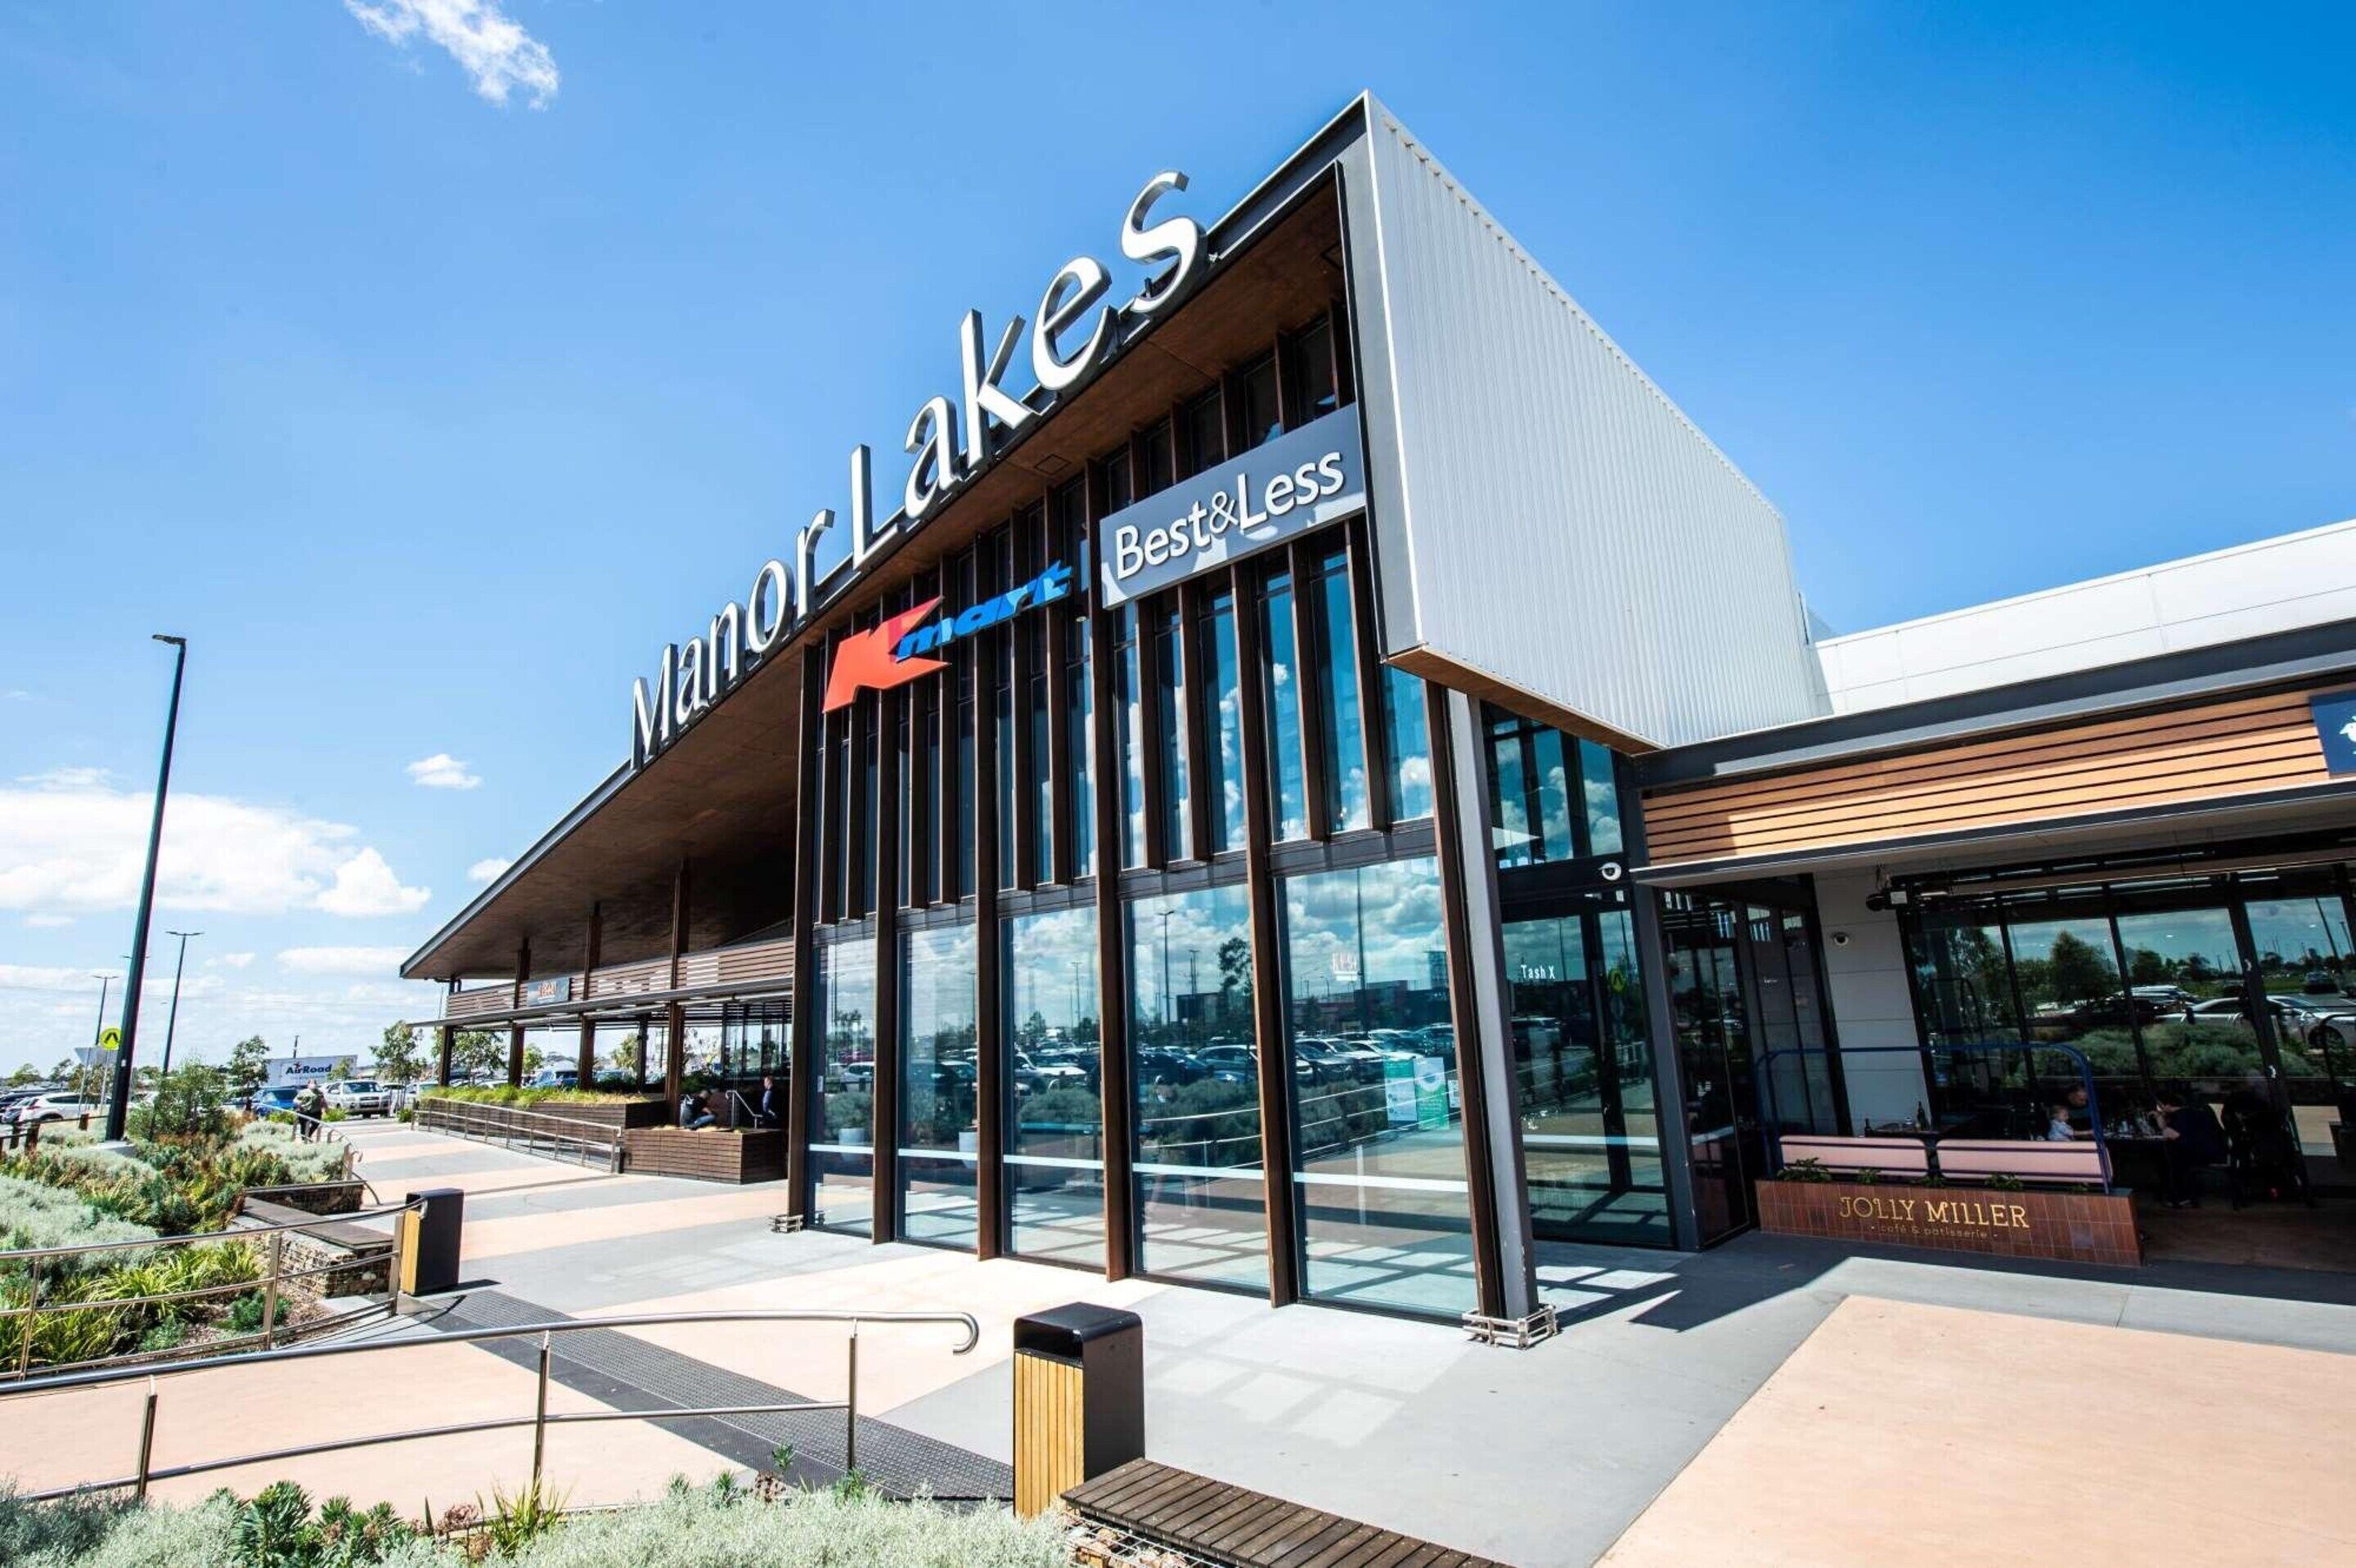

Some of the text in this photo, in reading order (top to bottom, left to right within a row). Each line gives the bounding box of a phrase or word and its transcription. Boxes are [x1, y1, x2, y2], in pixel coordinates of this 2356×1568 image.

[630, 170, 1206, 771] Manor Lakes
[1115, 451, 1345, 581] Best&Less
[822, 559, 1074, 714] Kmart
[286, 1063, 331, 1074] AirRoad
[1841, 1197, 2029, 1228] JOLLY MILLER
